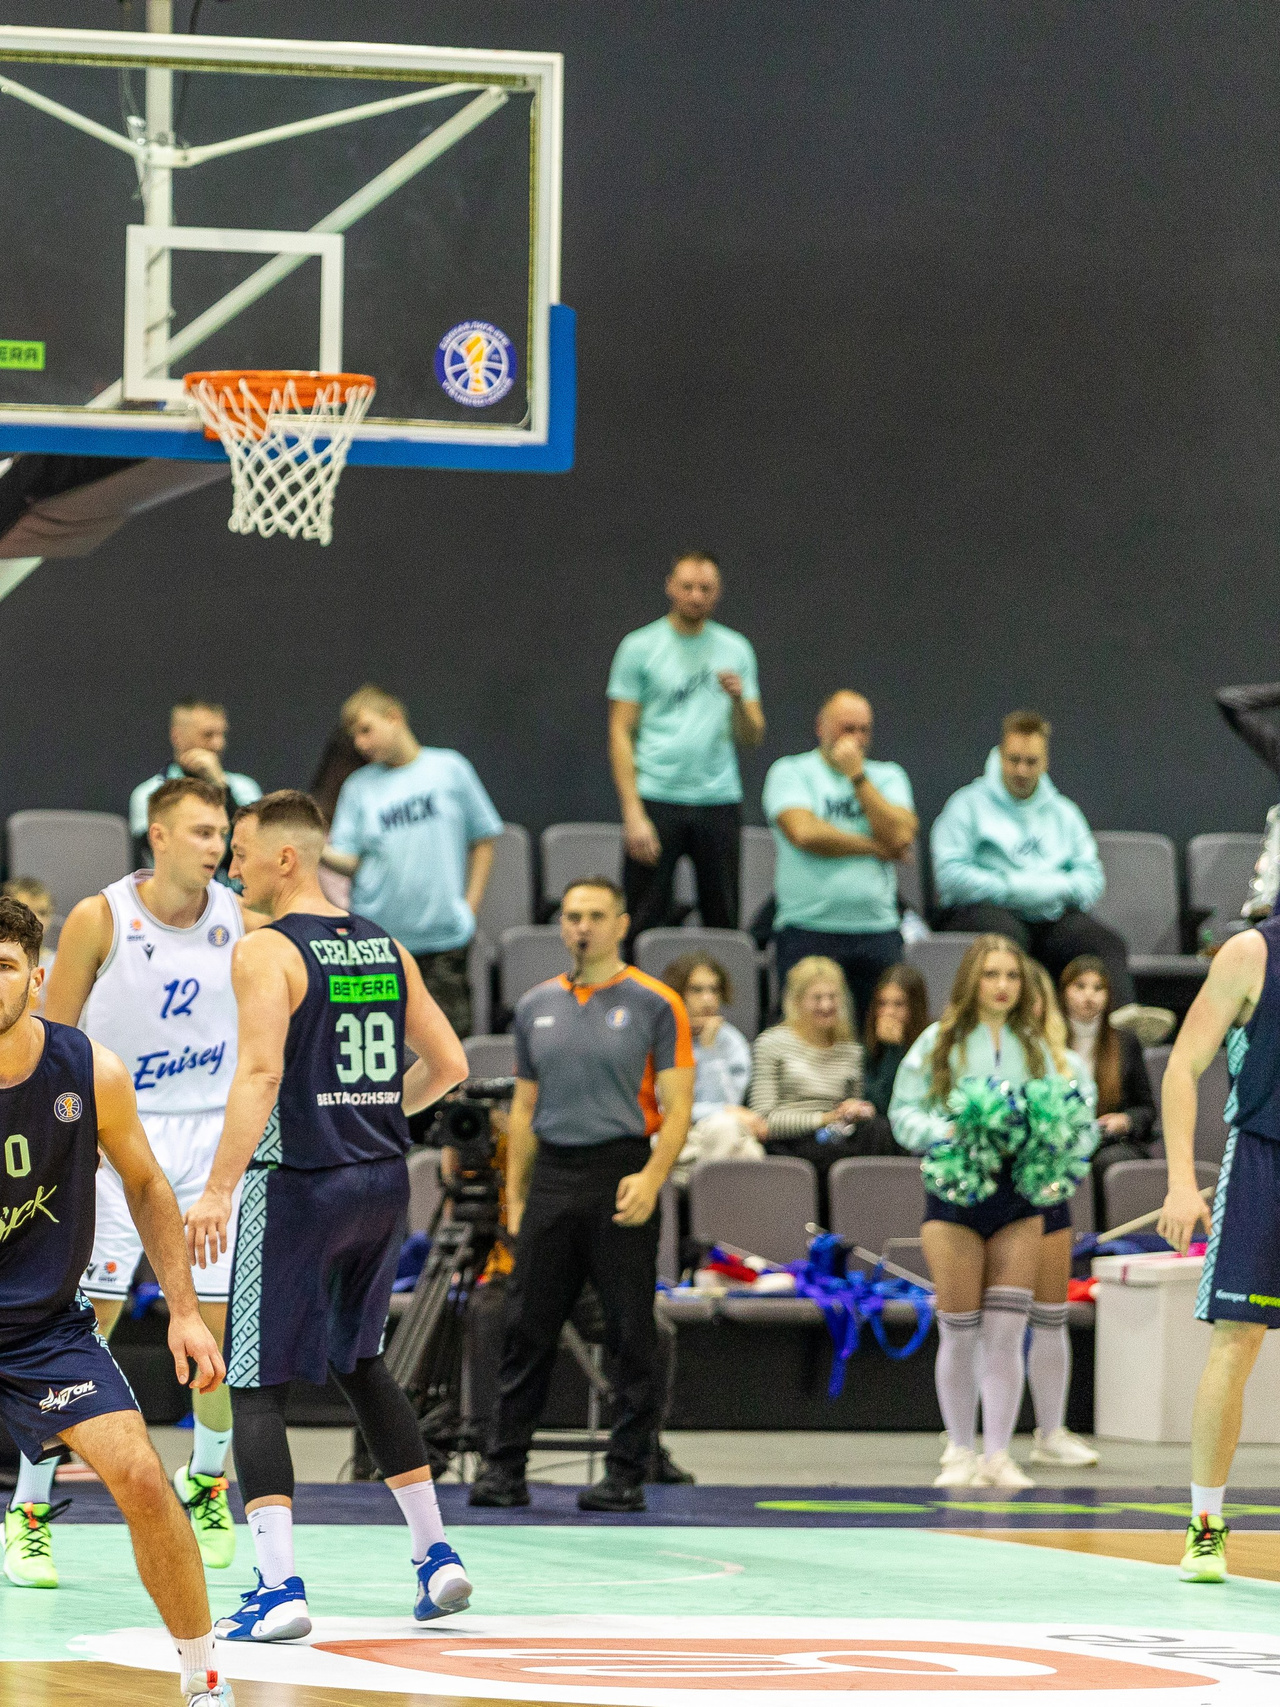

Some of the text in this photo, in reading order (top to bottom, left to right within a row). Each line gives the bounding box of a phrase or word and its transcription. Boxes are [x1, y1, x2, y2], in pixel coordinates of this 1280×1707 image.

[160, 978, 200, 1020] 12
[133, 1040, 227, 1092] Enisey
[335, 1012, 397, 1084] 38
[4, 1134, 32, 1178] 0
